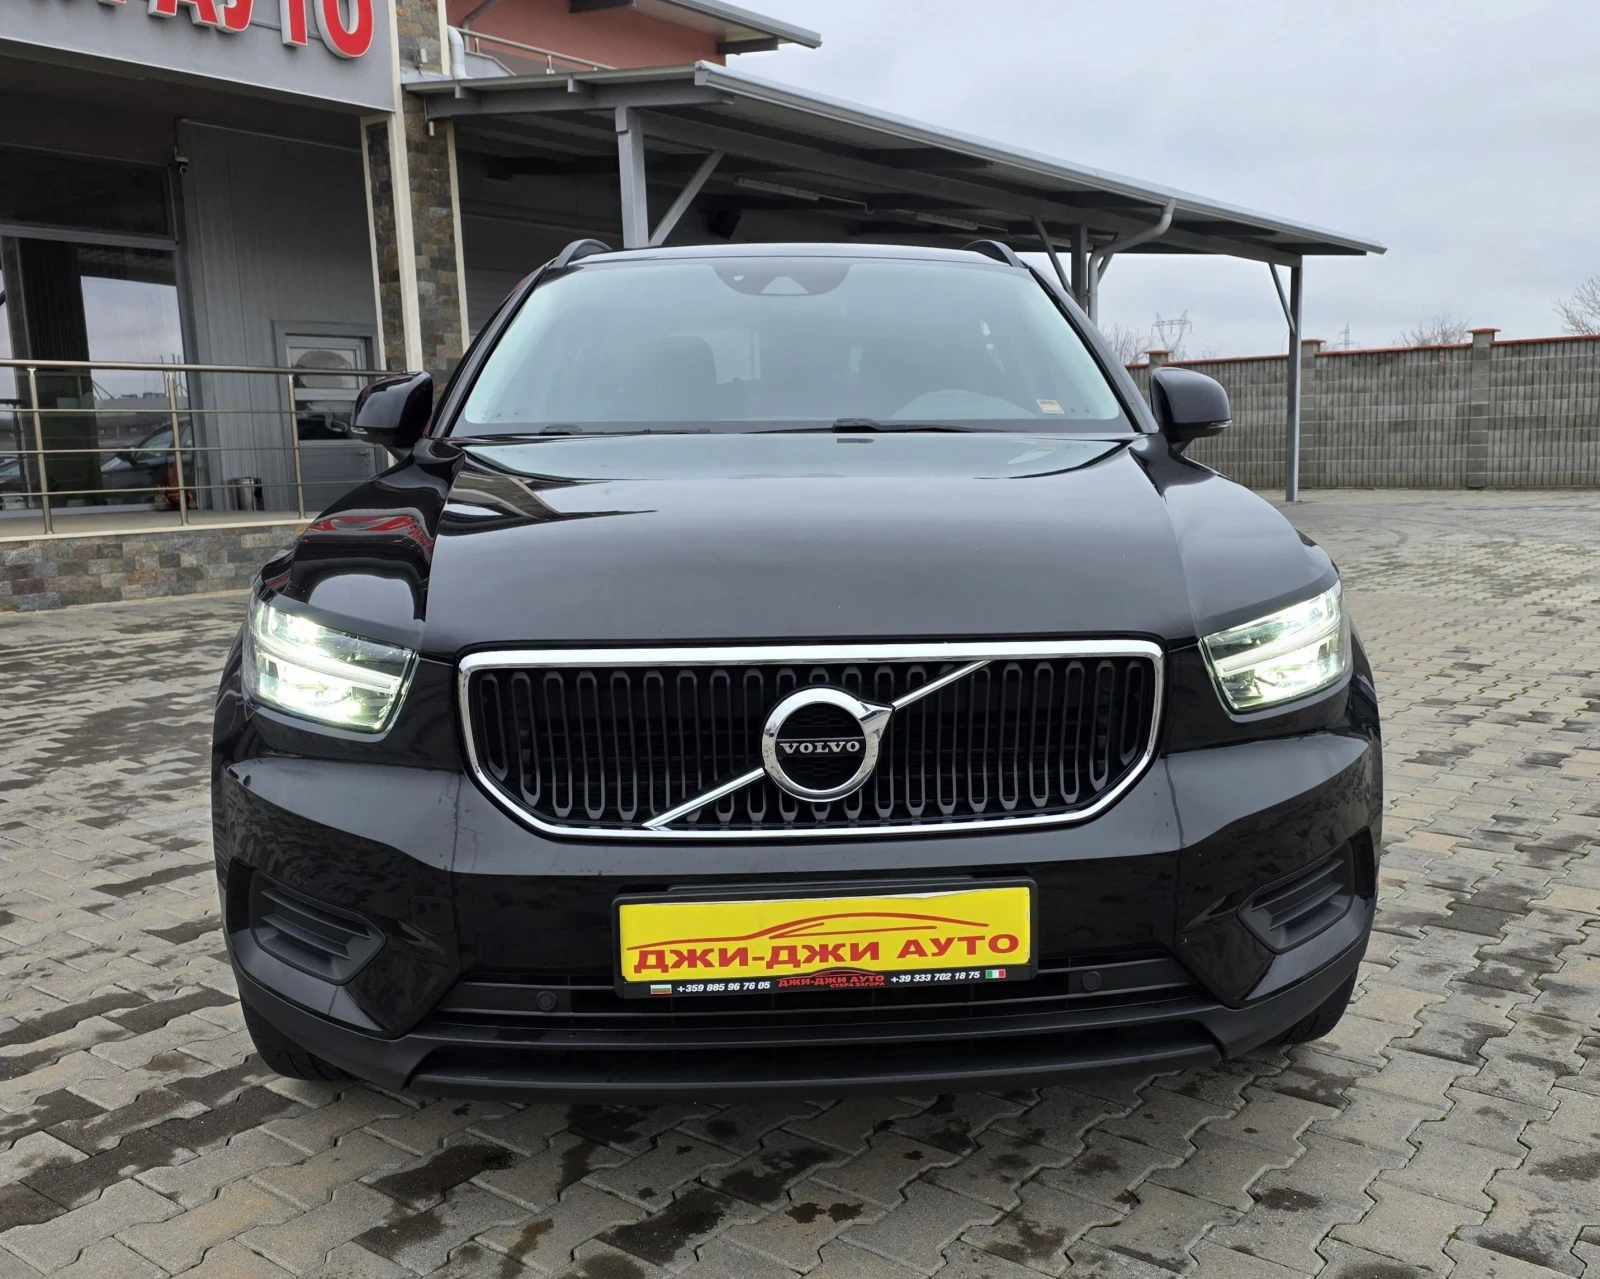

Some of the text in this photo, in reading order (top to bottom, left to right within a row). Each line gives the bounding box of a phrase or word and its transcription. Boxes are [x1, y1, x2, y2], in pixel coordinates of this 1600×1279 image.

[780, 741, 860, 754] VOLVO
[634, 934, 1019, 973] ДЖИ-ДЖИ АУТО
[778, 975, 885, 988] ДЖИ-ДЖИ АУТО
[890, 971, 981, 983] +39 333 702 18 75
[677, 981, 771, 993] +359 885 96 76 05
